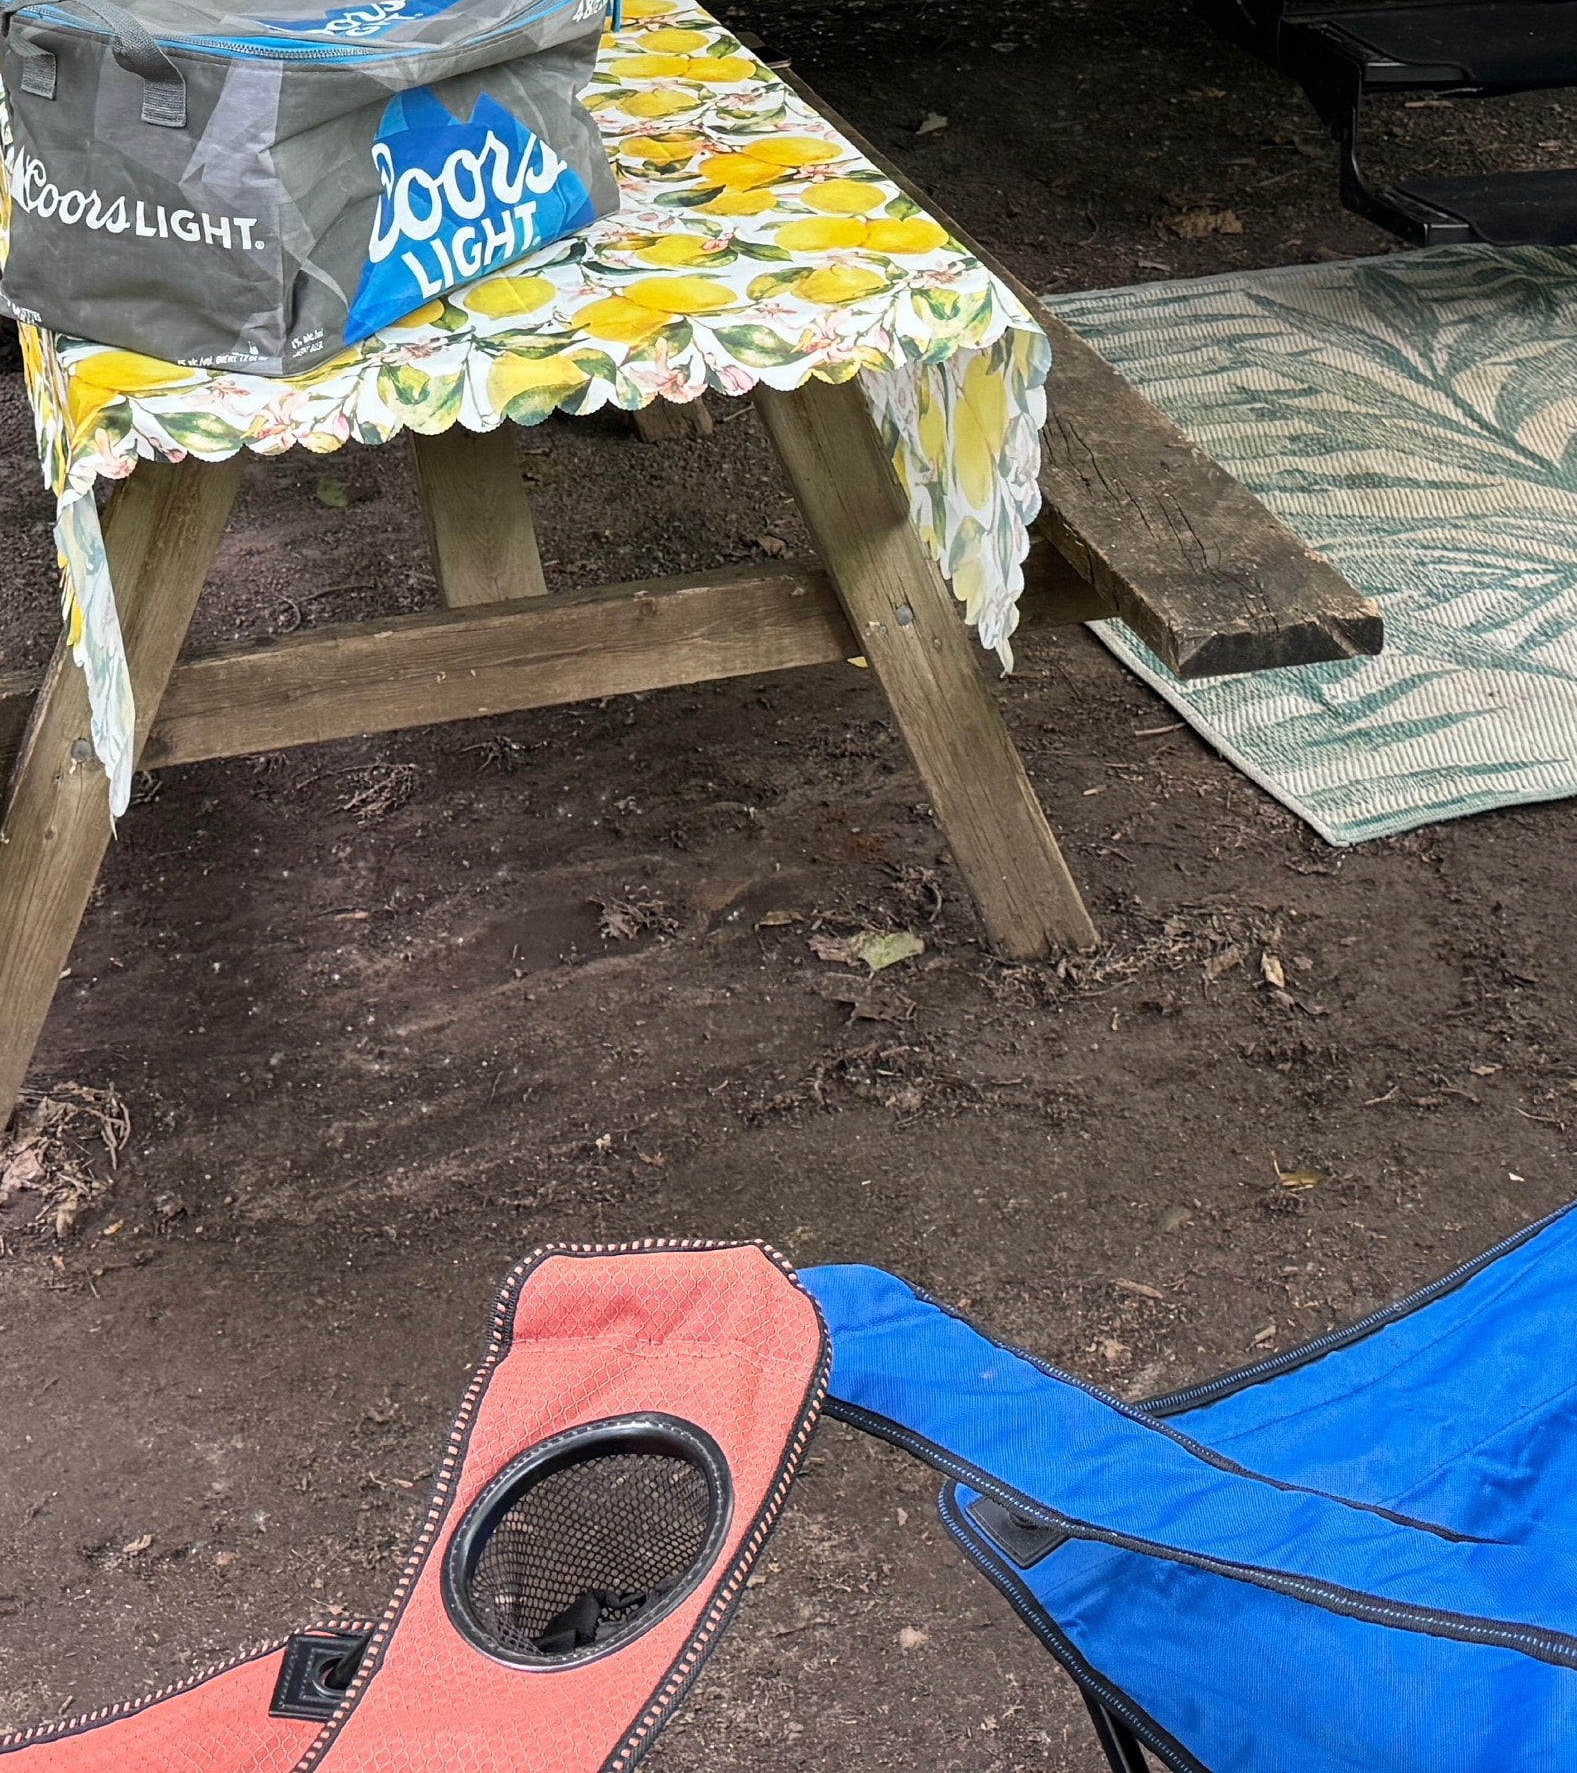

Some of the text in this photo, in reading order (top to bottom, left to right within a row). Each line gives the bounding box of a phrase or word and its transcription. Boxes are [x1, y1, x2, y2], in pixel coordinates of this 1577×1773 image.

[24, 154, 257, 250] Coors LIGHT
[401, 200, 538, 300] LIGHT
